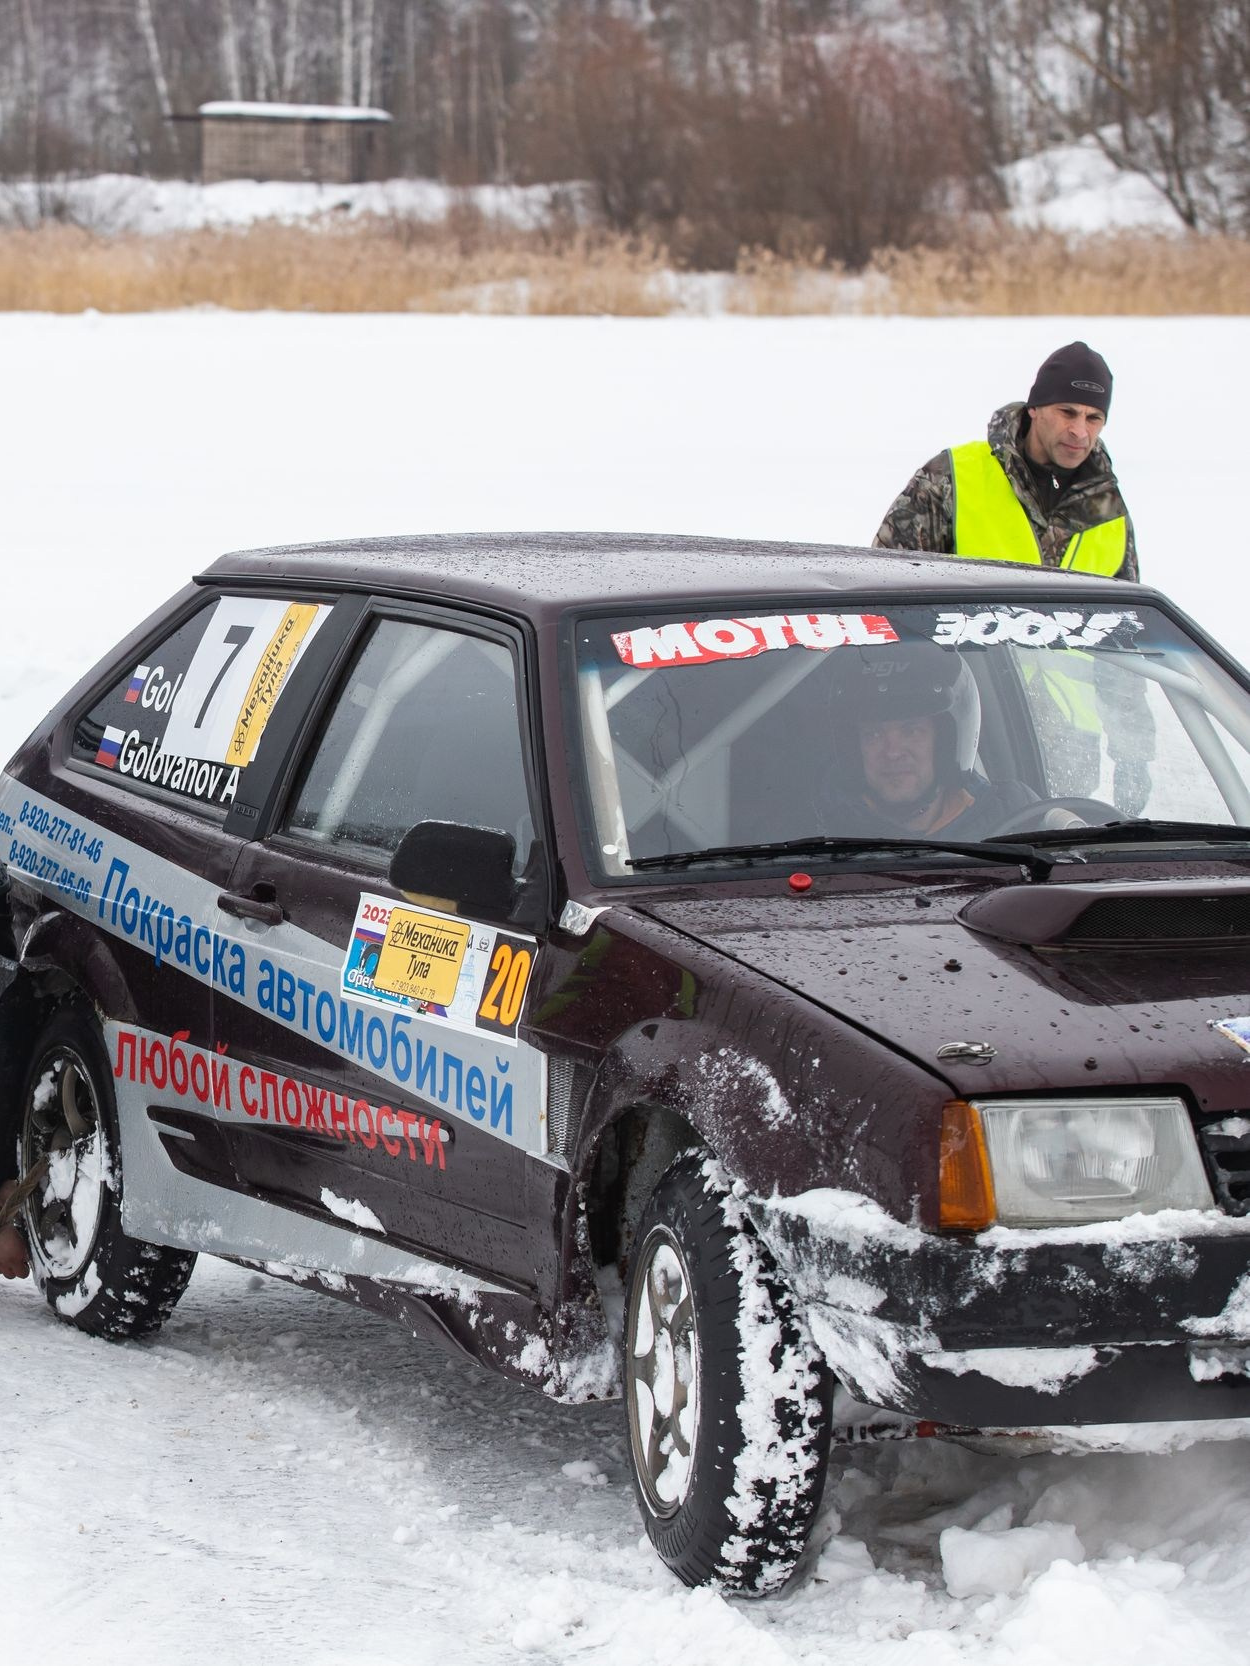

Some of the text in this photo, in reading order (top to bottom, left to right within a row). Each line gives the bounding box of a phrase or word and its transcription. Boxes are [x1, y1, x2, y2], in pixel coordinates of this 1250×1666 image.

[630, 613, 887, 664] MOTUL
[141, 665, 183, 713] Gol
[194, 625, 255, 729] 7
[119, 729, 223, 799] Golovanov
[19, 800, 104, 864] 8-920-277-81-46
[9, 839, 92, 904] 8-920-277-95-06
[401, 920, 459, 957] Механика
[407, 953, 430, 981] Тула
[98, 857, 246, 997] Покраска
[257, 958, 514, 1137] автомобилей
[477, 943, 532, 1027] 20
